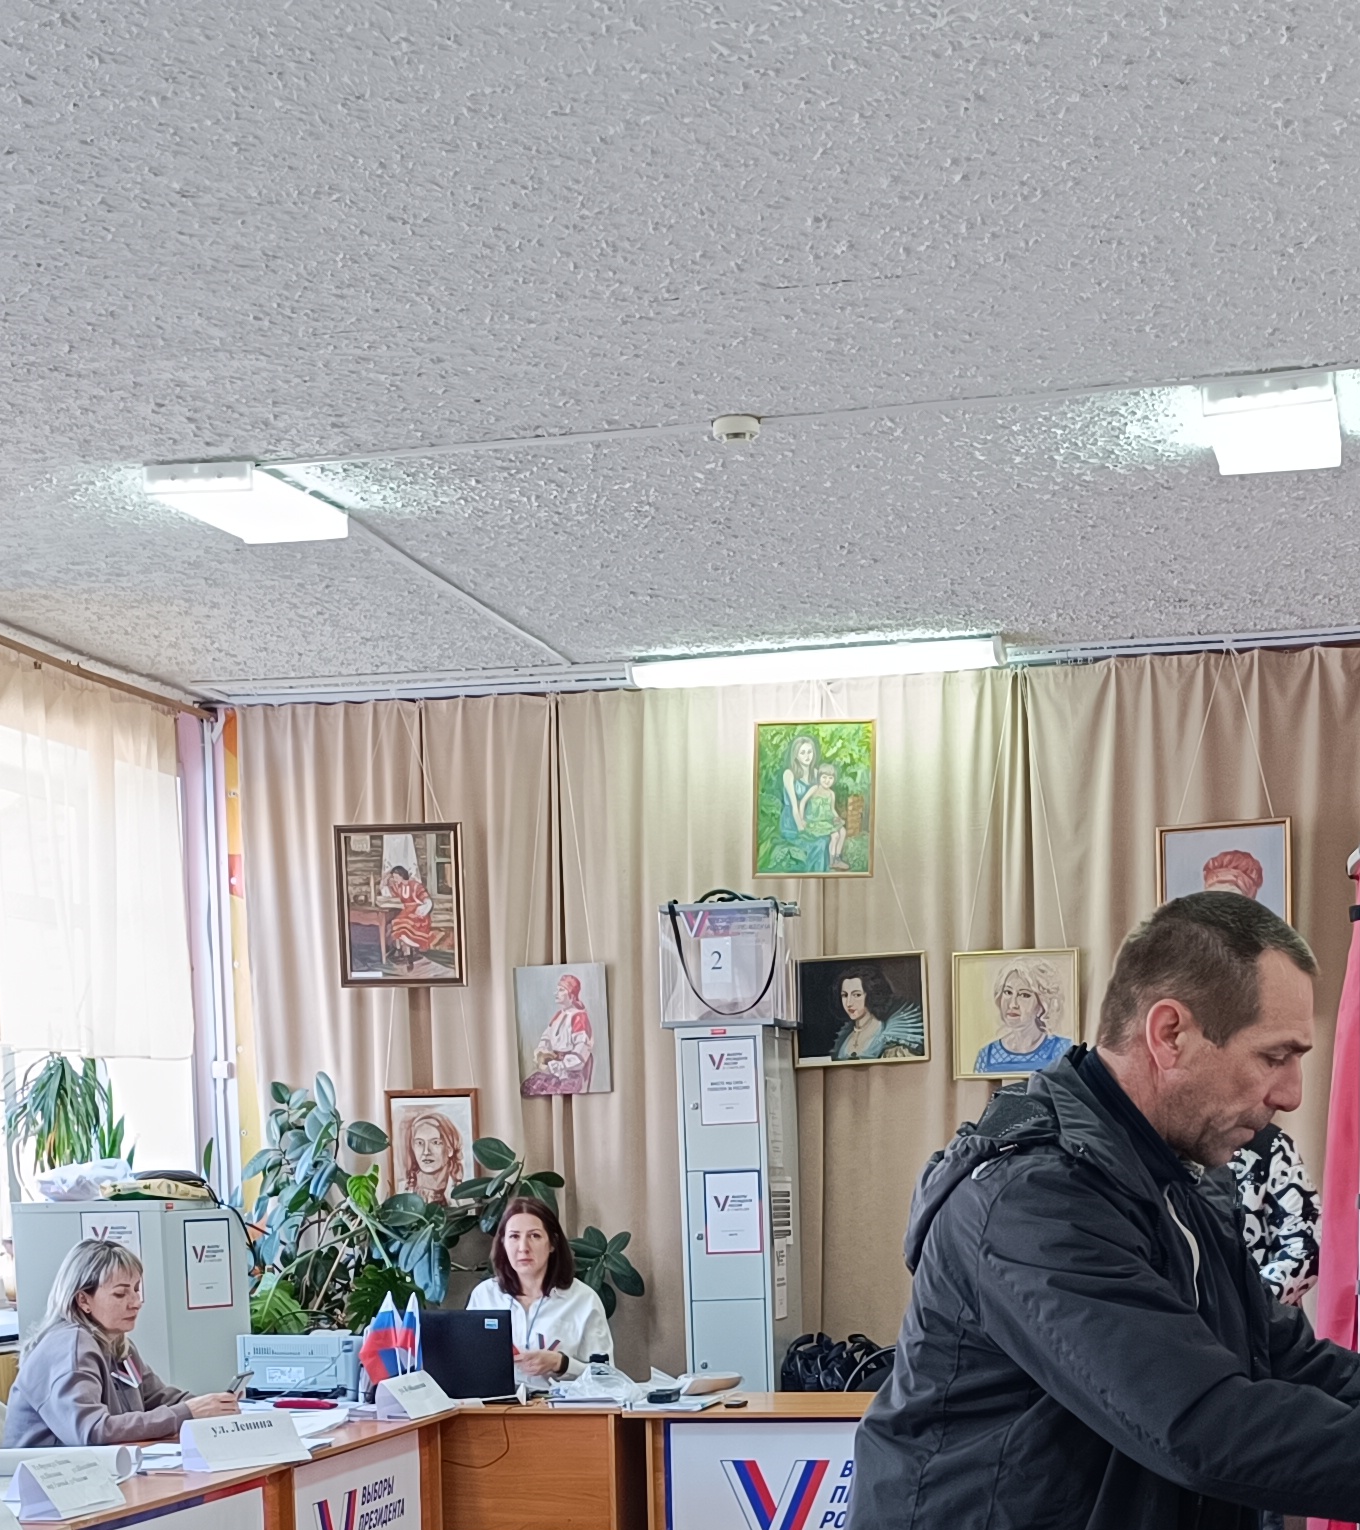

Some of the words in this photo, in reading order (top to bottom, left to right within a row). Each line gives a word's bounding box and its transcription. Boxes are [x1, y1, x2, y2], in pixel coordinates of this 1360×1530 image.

[710, 950, 723, 970] 2
[211, 1426, 229, 1437] ул.
[231, 1419, 273, 1432] Ленина
[361, 1475, 395, 1506] ВЫБОРЫ
